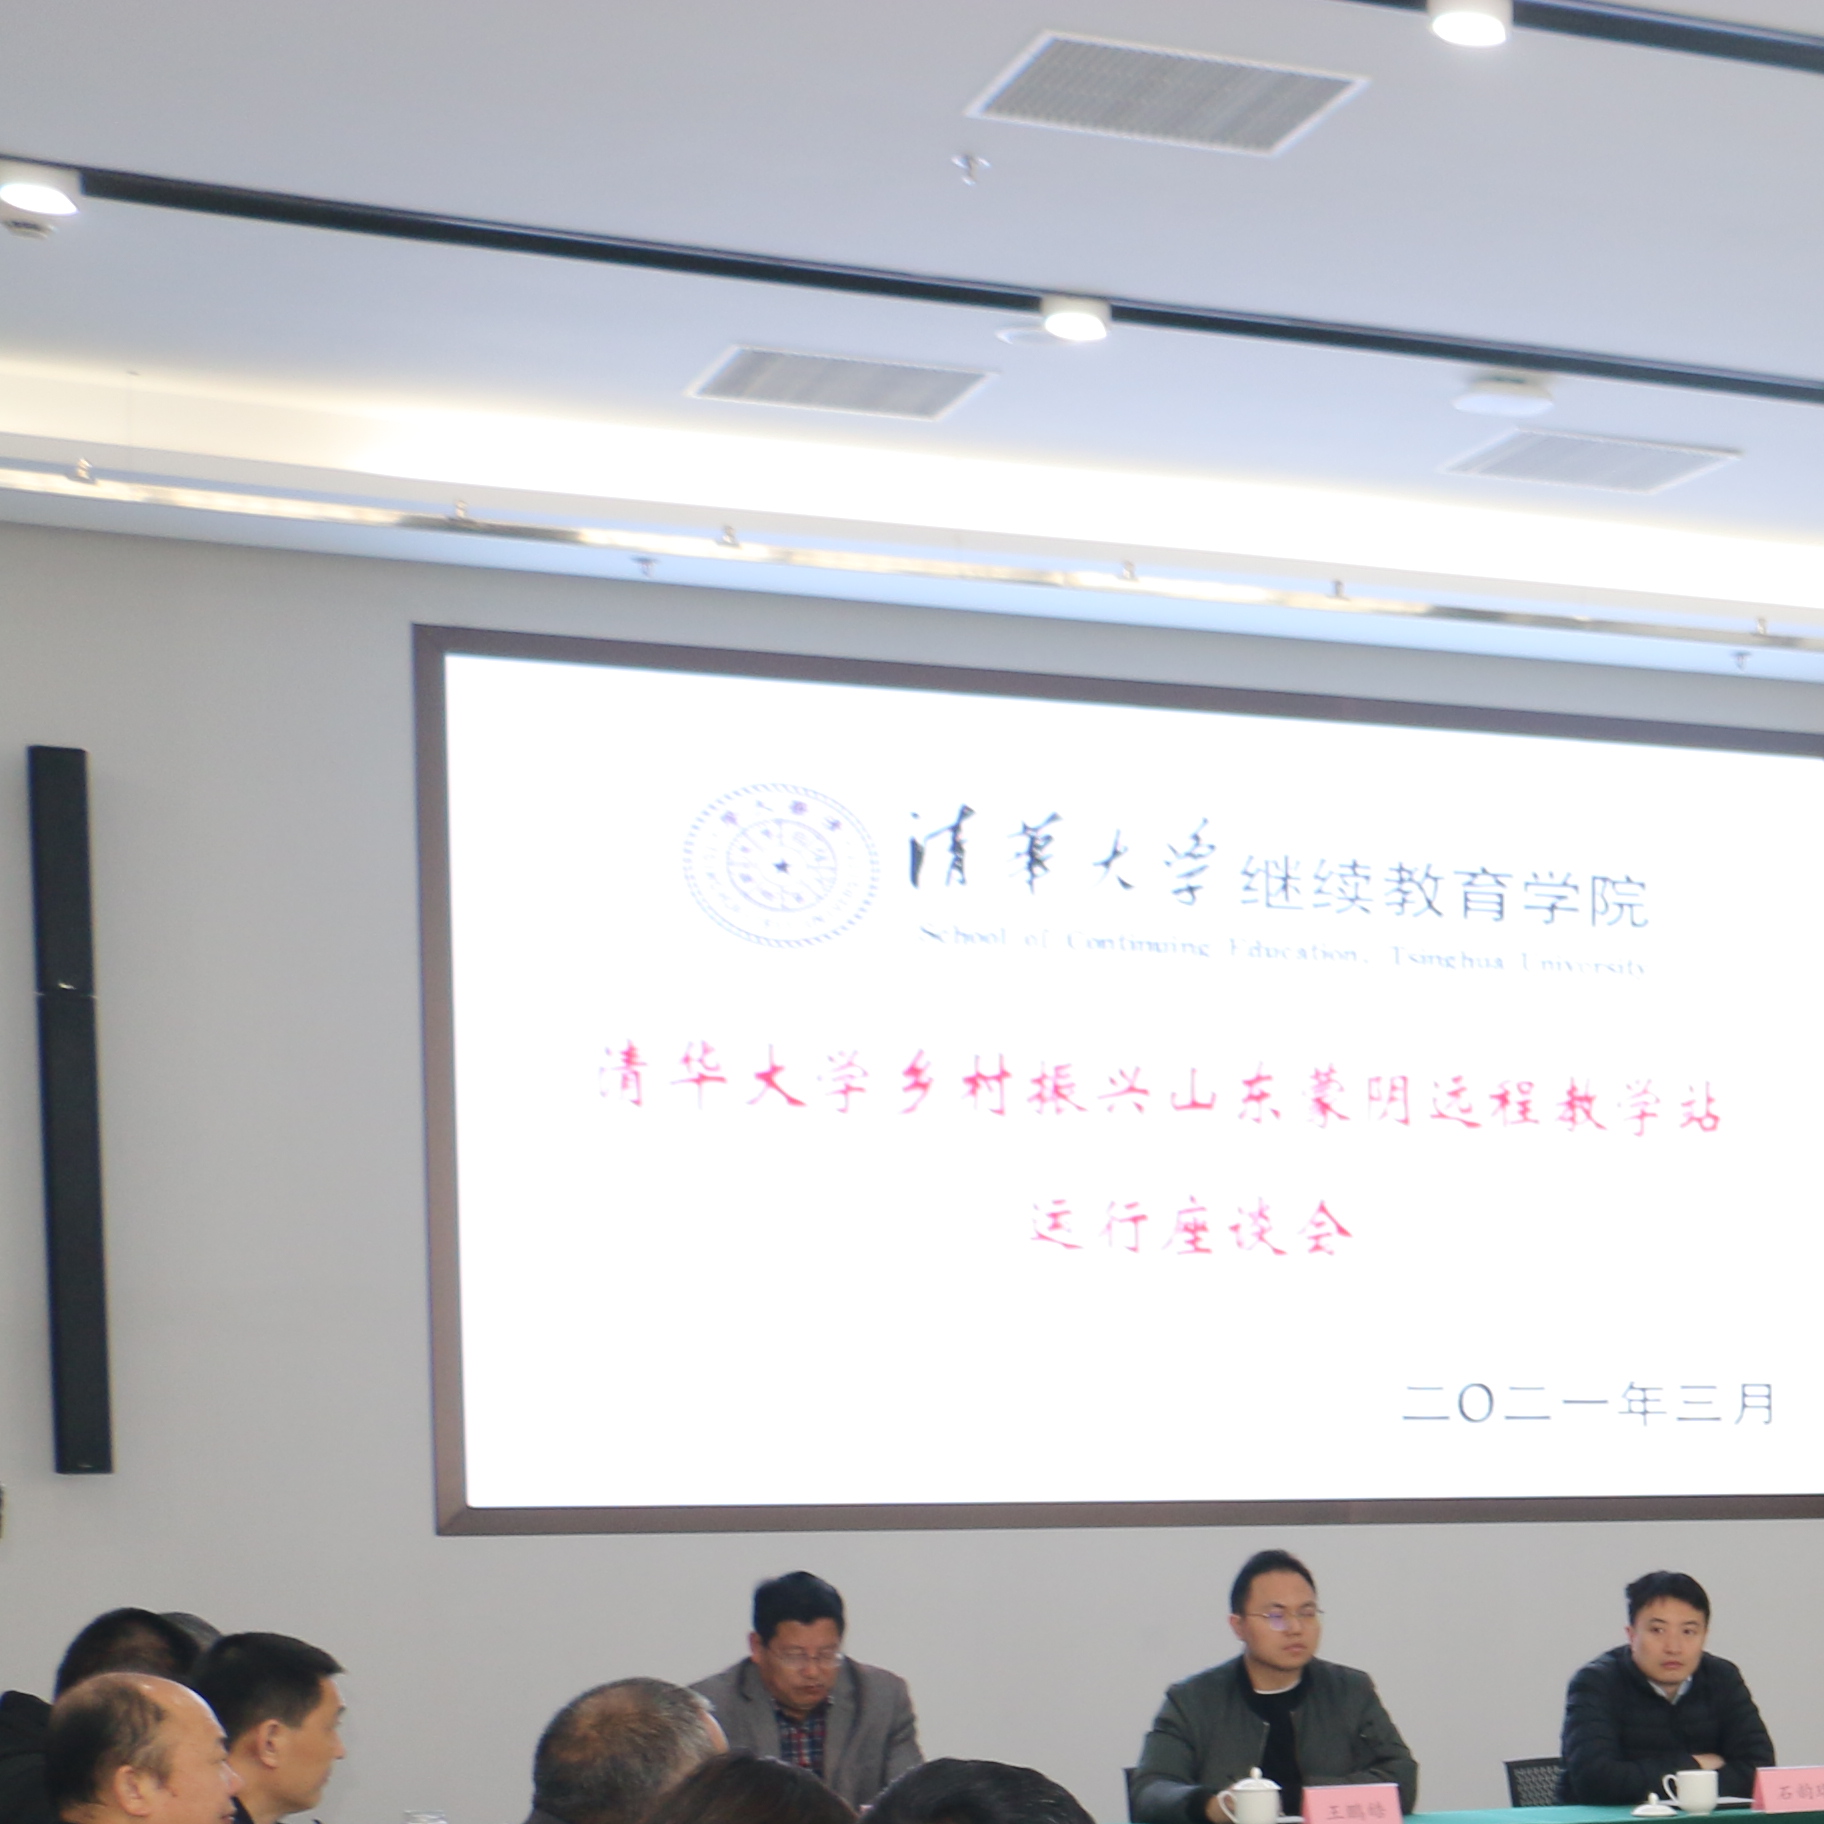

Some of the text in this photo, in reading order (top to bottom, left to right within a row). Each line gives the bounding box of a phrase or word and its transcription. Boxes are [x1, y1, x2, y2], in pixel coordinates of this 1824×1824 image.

[919, 924, 1007, 945] School
[1024, 928, 1049, 948] of
[1066, 933, 1211, 958] Continuing
[1389, 944, 1505, 971] Tsinghua
[1030, 1194, 1353, 1256] 运行座谈会
